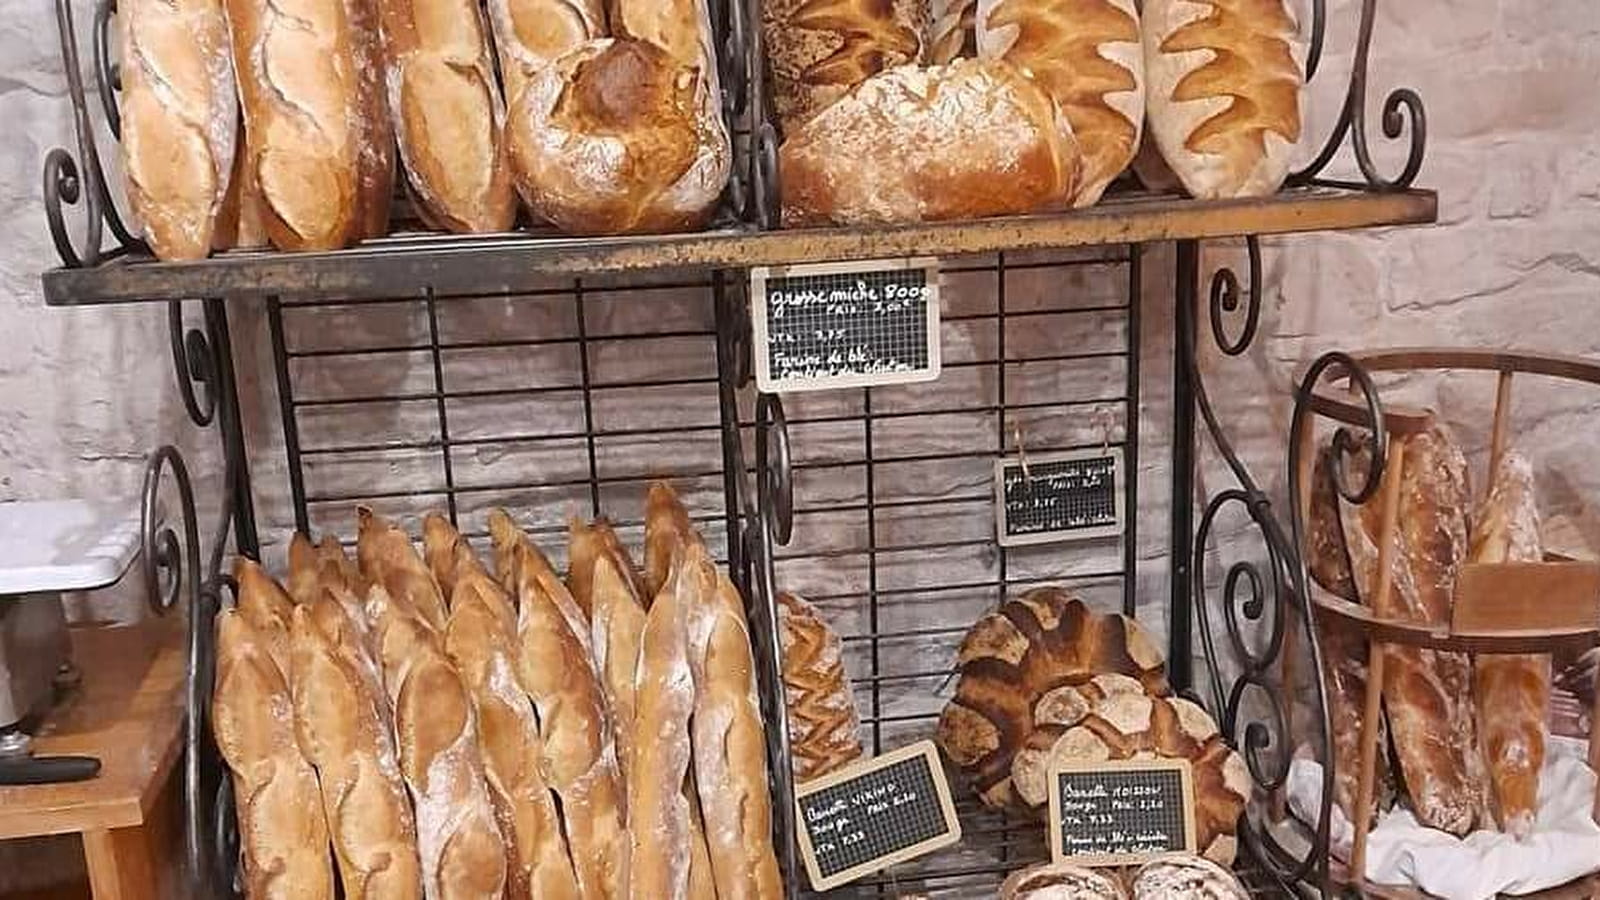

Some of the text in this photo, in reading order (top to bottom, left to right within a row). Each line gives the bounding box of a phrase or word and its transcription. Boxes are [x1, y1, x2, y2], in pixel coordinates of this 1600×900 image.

[771, 290, 827, 318] grosse
[830, 281, 878, 302] miche
[774, 352, 820, 367] Farine
[827, 349, 842, 364] de
